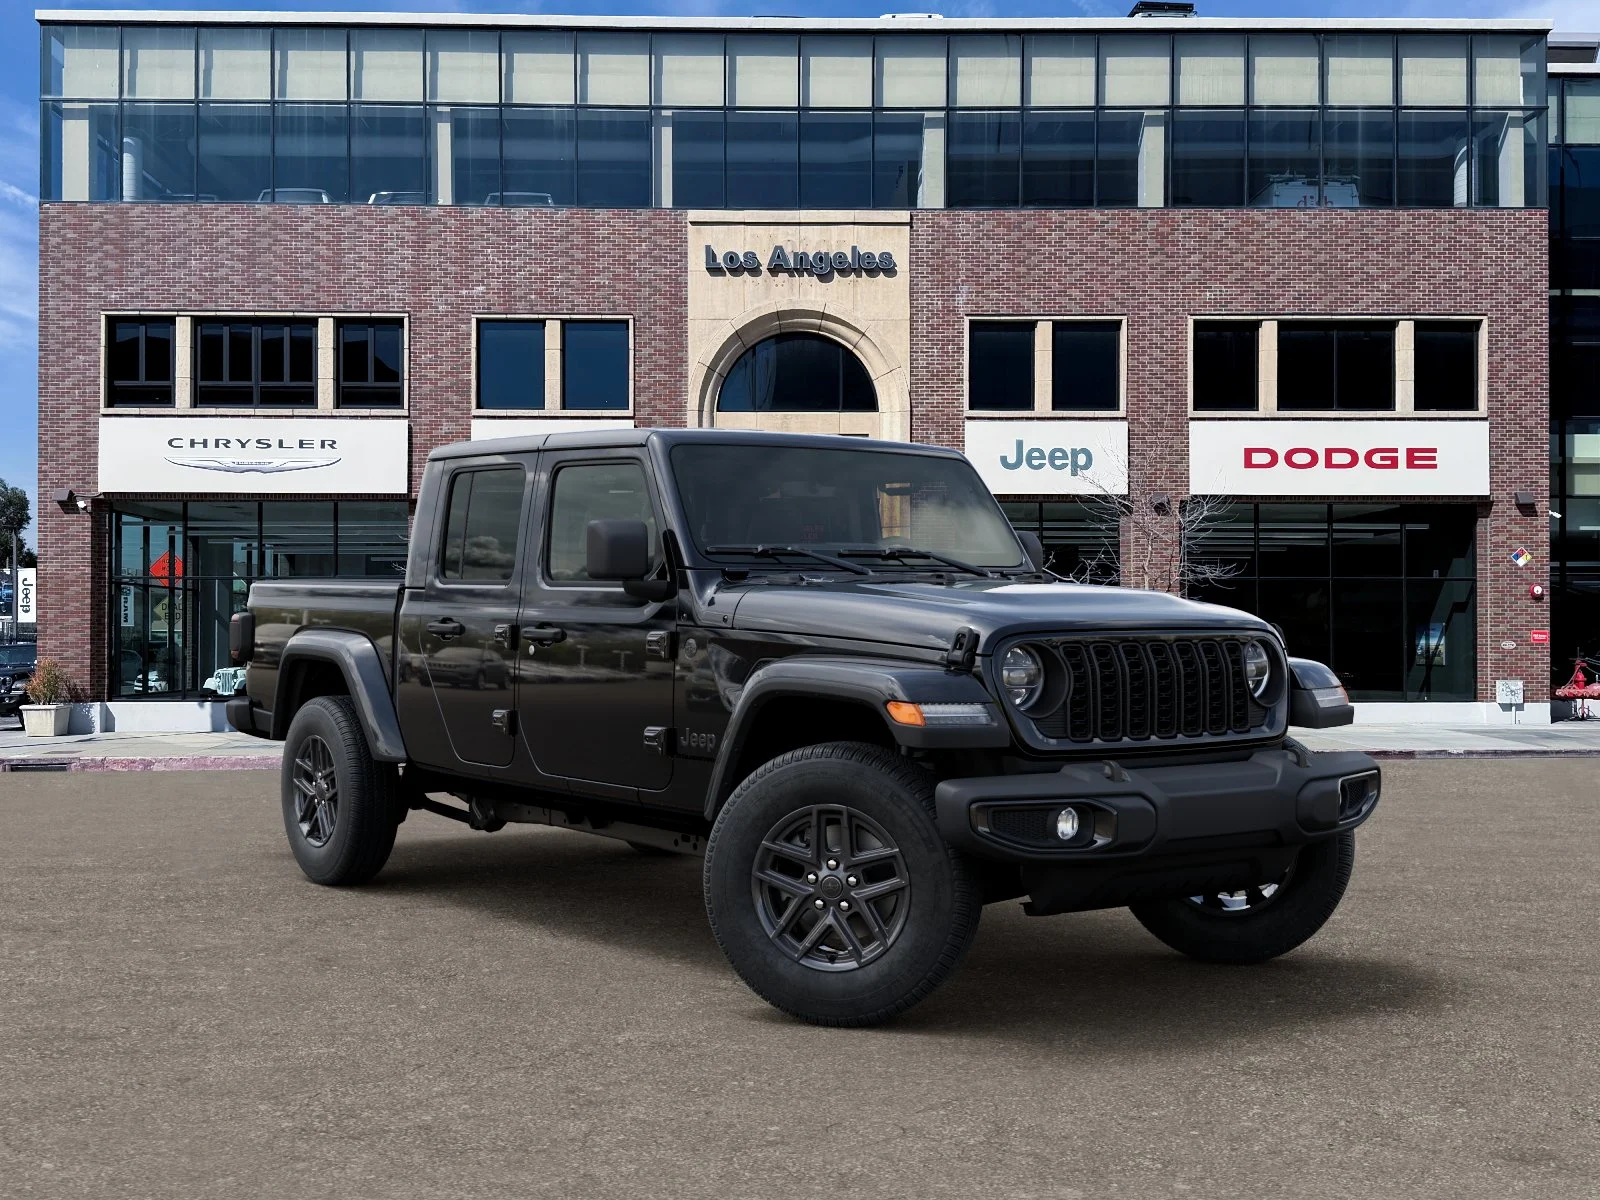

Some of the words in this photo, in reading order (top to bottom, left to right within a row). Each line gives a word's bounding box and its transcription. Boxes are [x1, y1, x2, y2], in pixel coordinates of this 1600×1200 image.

[1297, 195, 1334, 207] dih
[705, 245, 758, 269] Los
[767, 245, 895, 275] Angeles
[167, 437, 338, 450] CHRYSLER
[999, 439, 1094, 477] Jeep
[1243, 447, 1438, 470] DODGE
[20, 577, 34, 614] Jeep
[161, 603, 182, 611] DAD
[680, 727, 717, 752] Jeep
